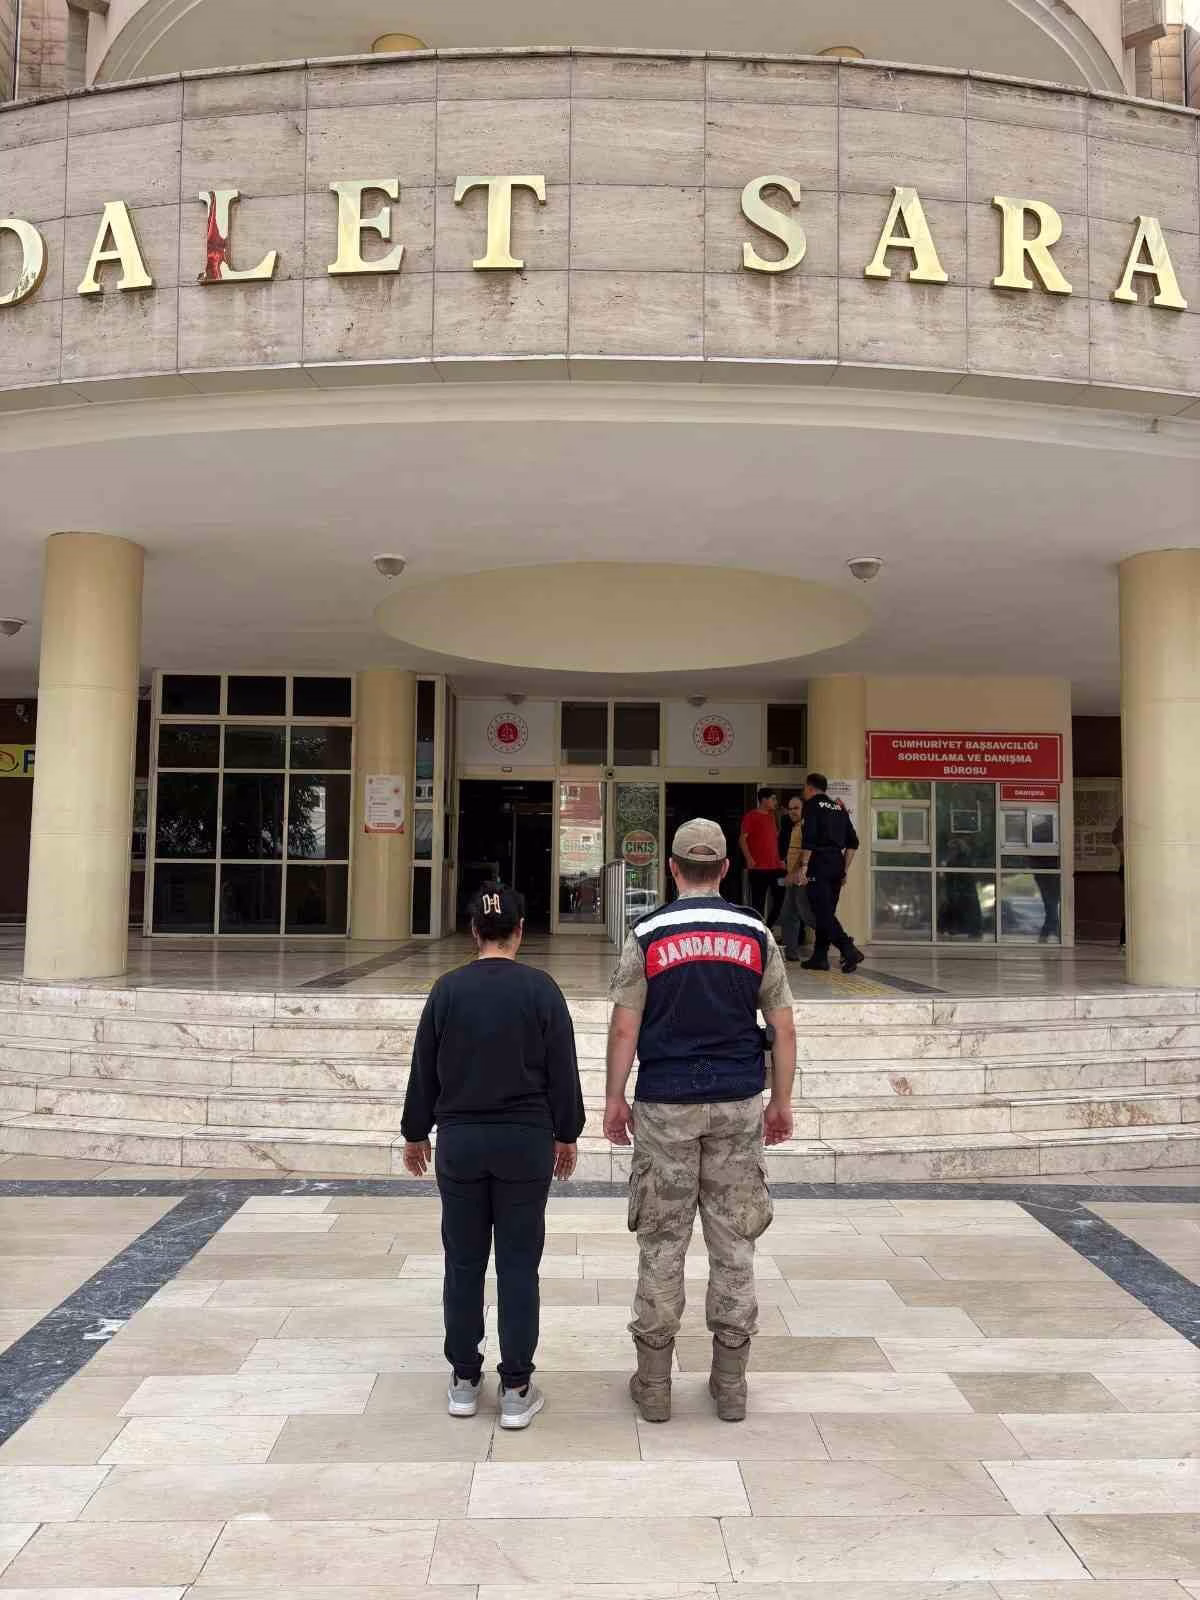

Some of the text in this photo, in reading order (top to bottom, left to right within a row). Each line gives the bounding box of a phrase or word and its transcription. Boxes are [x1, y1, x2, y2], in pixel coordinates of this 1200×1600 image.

[740, 175, 1188, 311] SARA
[891, 738, 1039, 751] CUMHURİYET BAŞSAVCILIĞI
[898, 752, 1032, 765] SORGULAMA VE DANIŞMA
[943, 764, 987, 775] BÜROSU
[657, 935, 752, 967] JANDARMA
